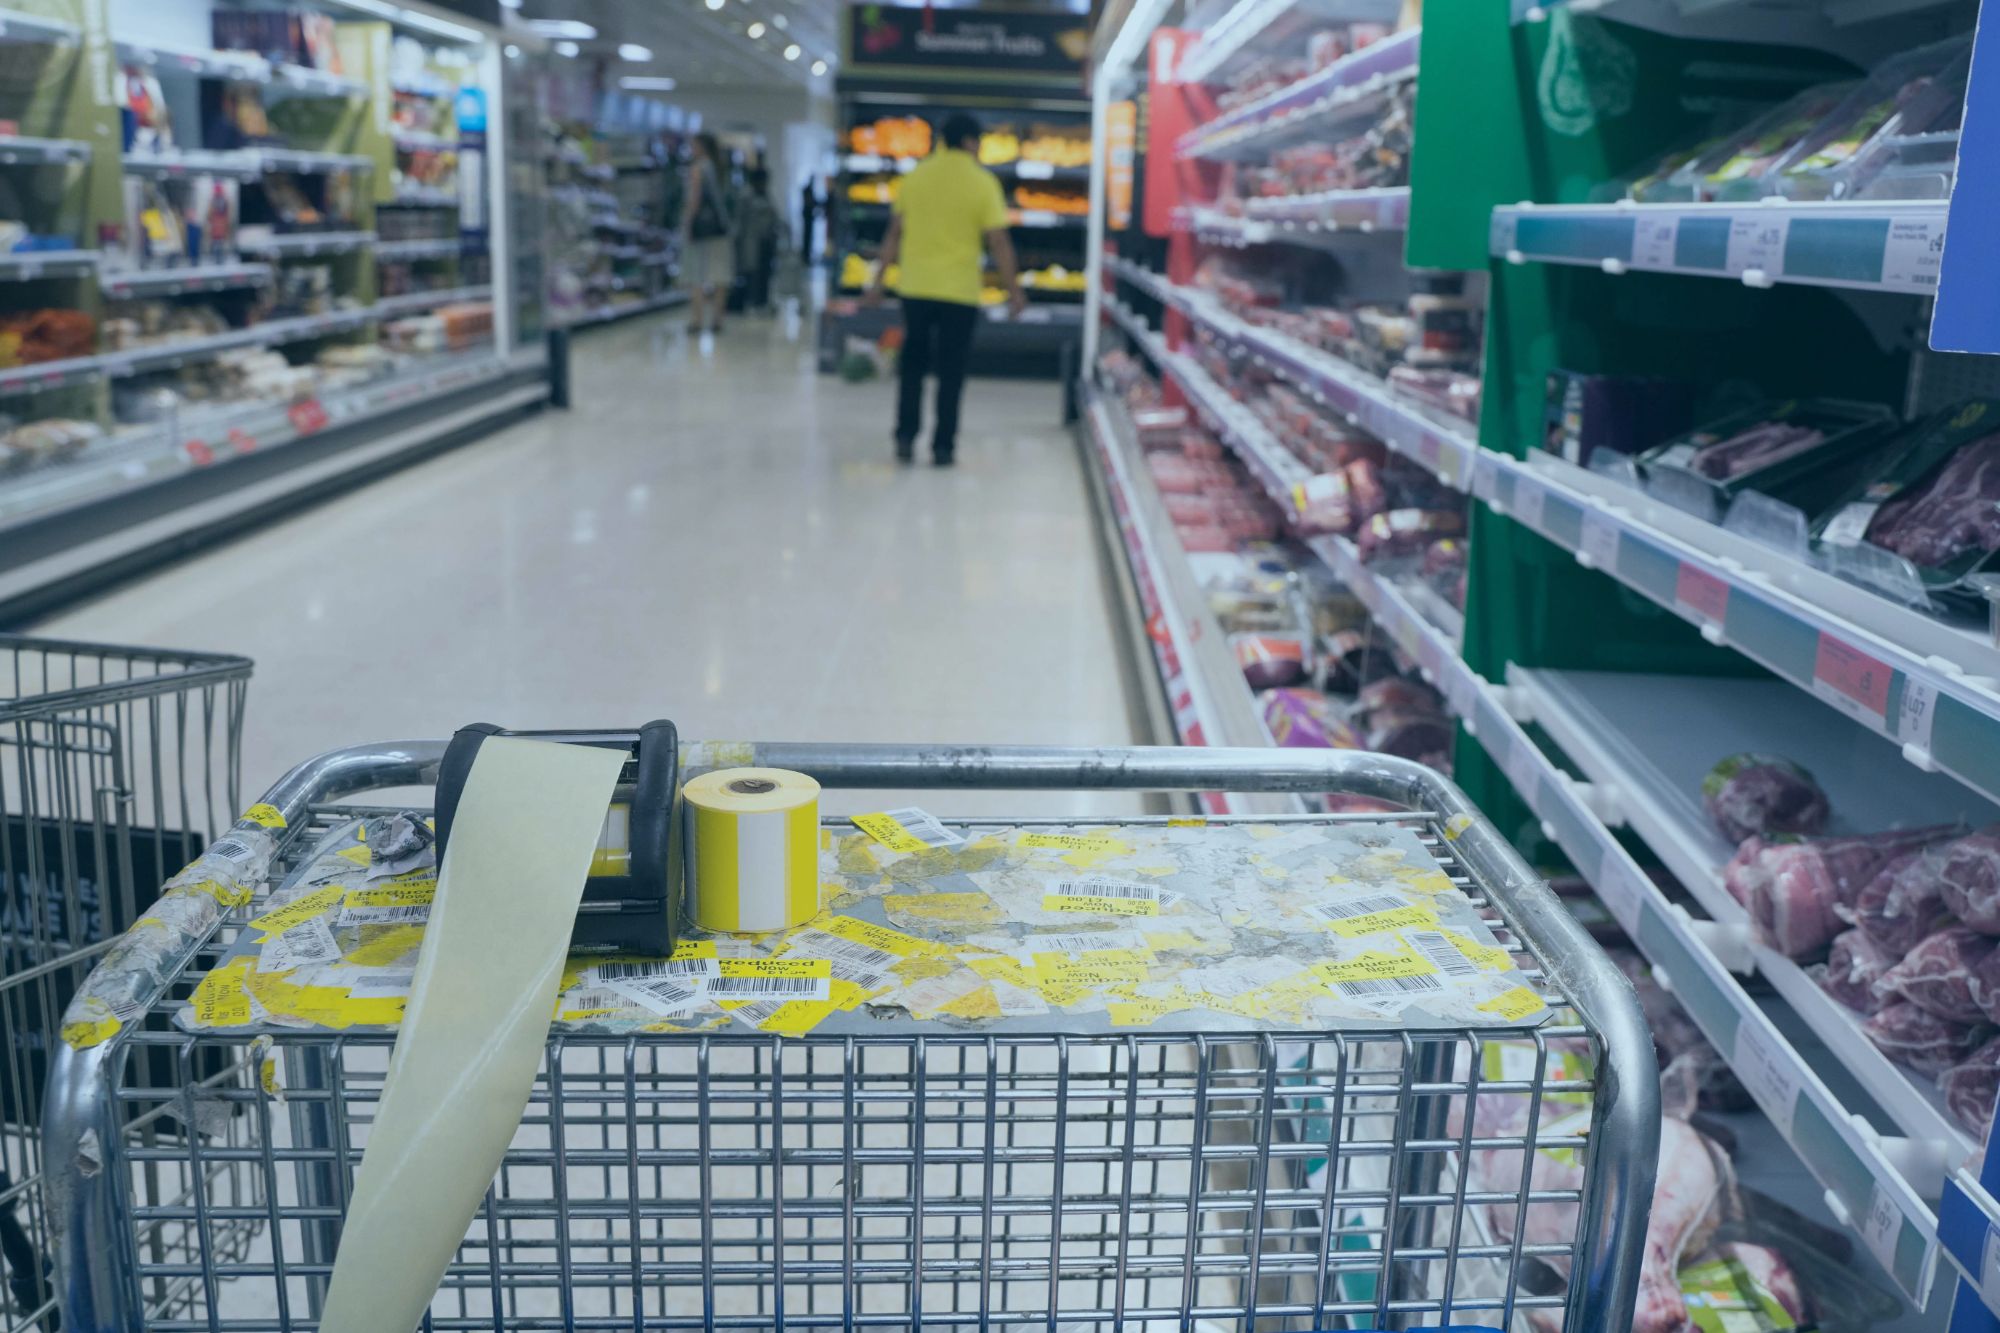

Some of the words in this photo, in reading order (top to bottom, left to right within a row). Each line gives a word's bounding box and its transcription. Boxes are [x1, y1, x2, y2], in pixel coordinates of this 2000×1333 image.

[861, 819, 902, 850] Reduced
[358, 889, 435, 897] Reduce
[1083, 901, 1113, 909] Now
[1059, 905, 1148, 916] Reduced
[719, 959, 815, 967] Reduced
[1325, 957, 1413, 971] Reduced
